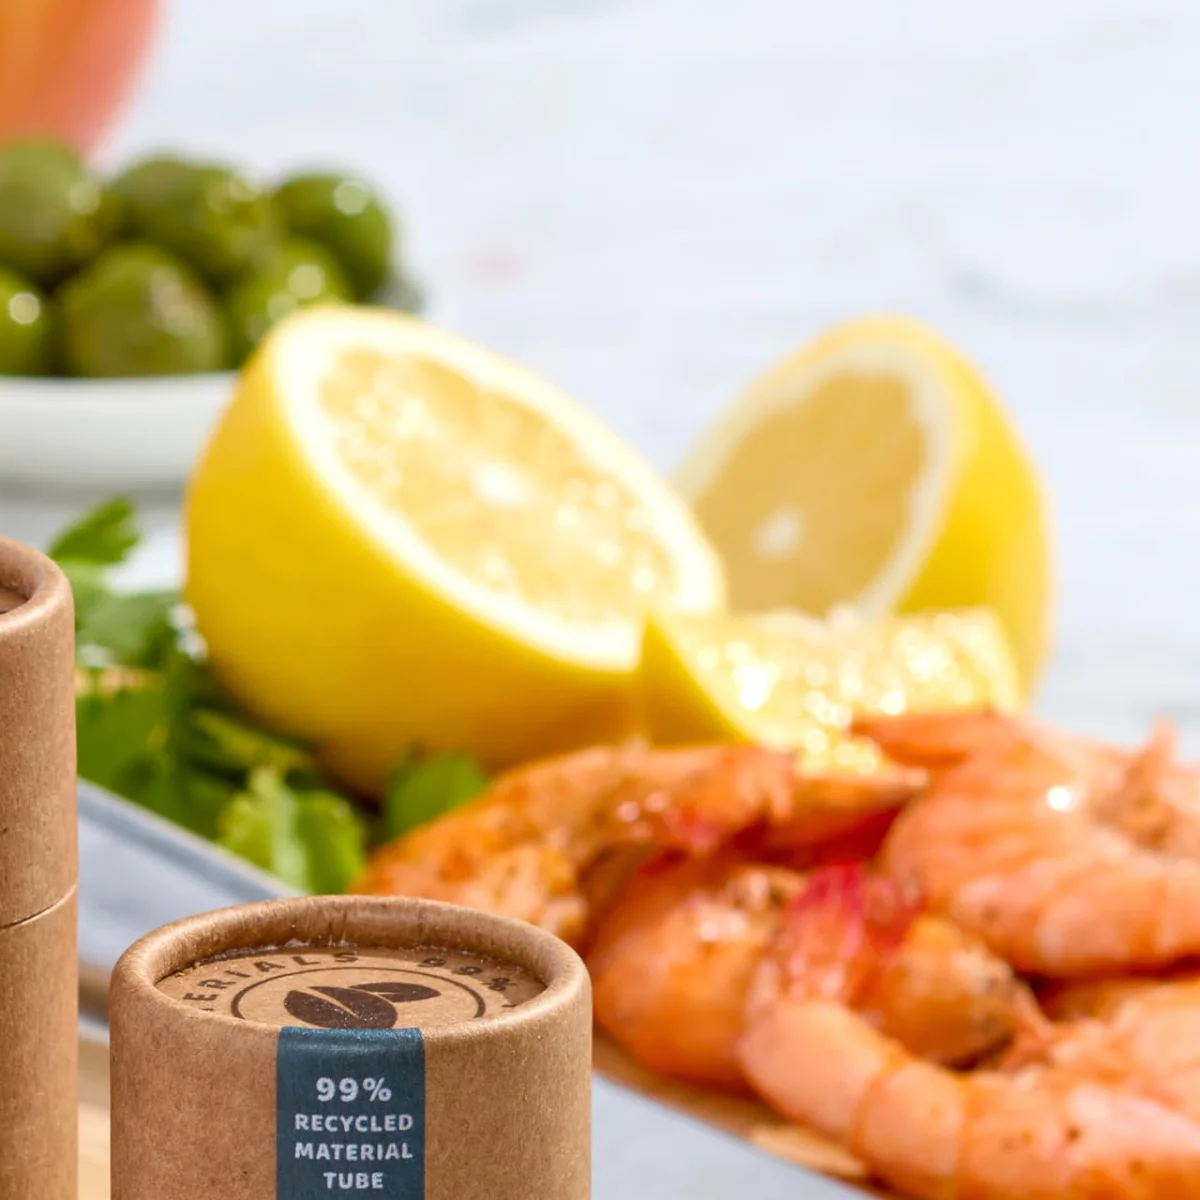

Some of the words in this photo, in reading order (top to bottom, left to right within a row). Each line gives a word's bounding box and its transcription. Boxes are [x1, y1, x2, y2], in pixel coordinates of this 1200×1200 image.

[183, 952, 359, 1010] ERIALS
[315, 1076, 392, 1102] 99%
[294, 1113, 414, 1132] RECYCLED
[294, 1142, 413, 1161] MATERIAL
[323, 1171, 384, 1190] TUBE
